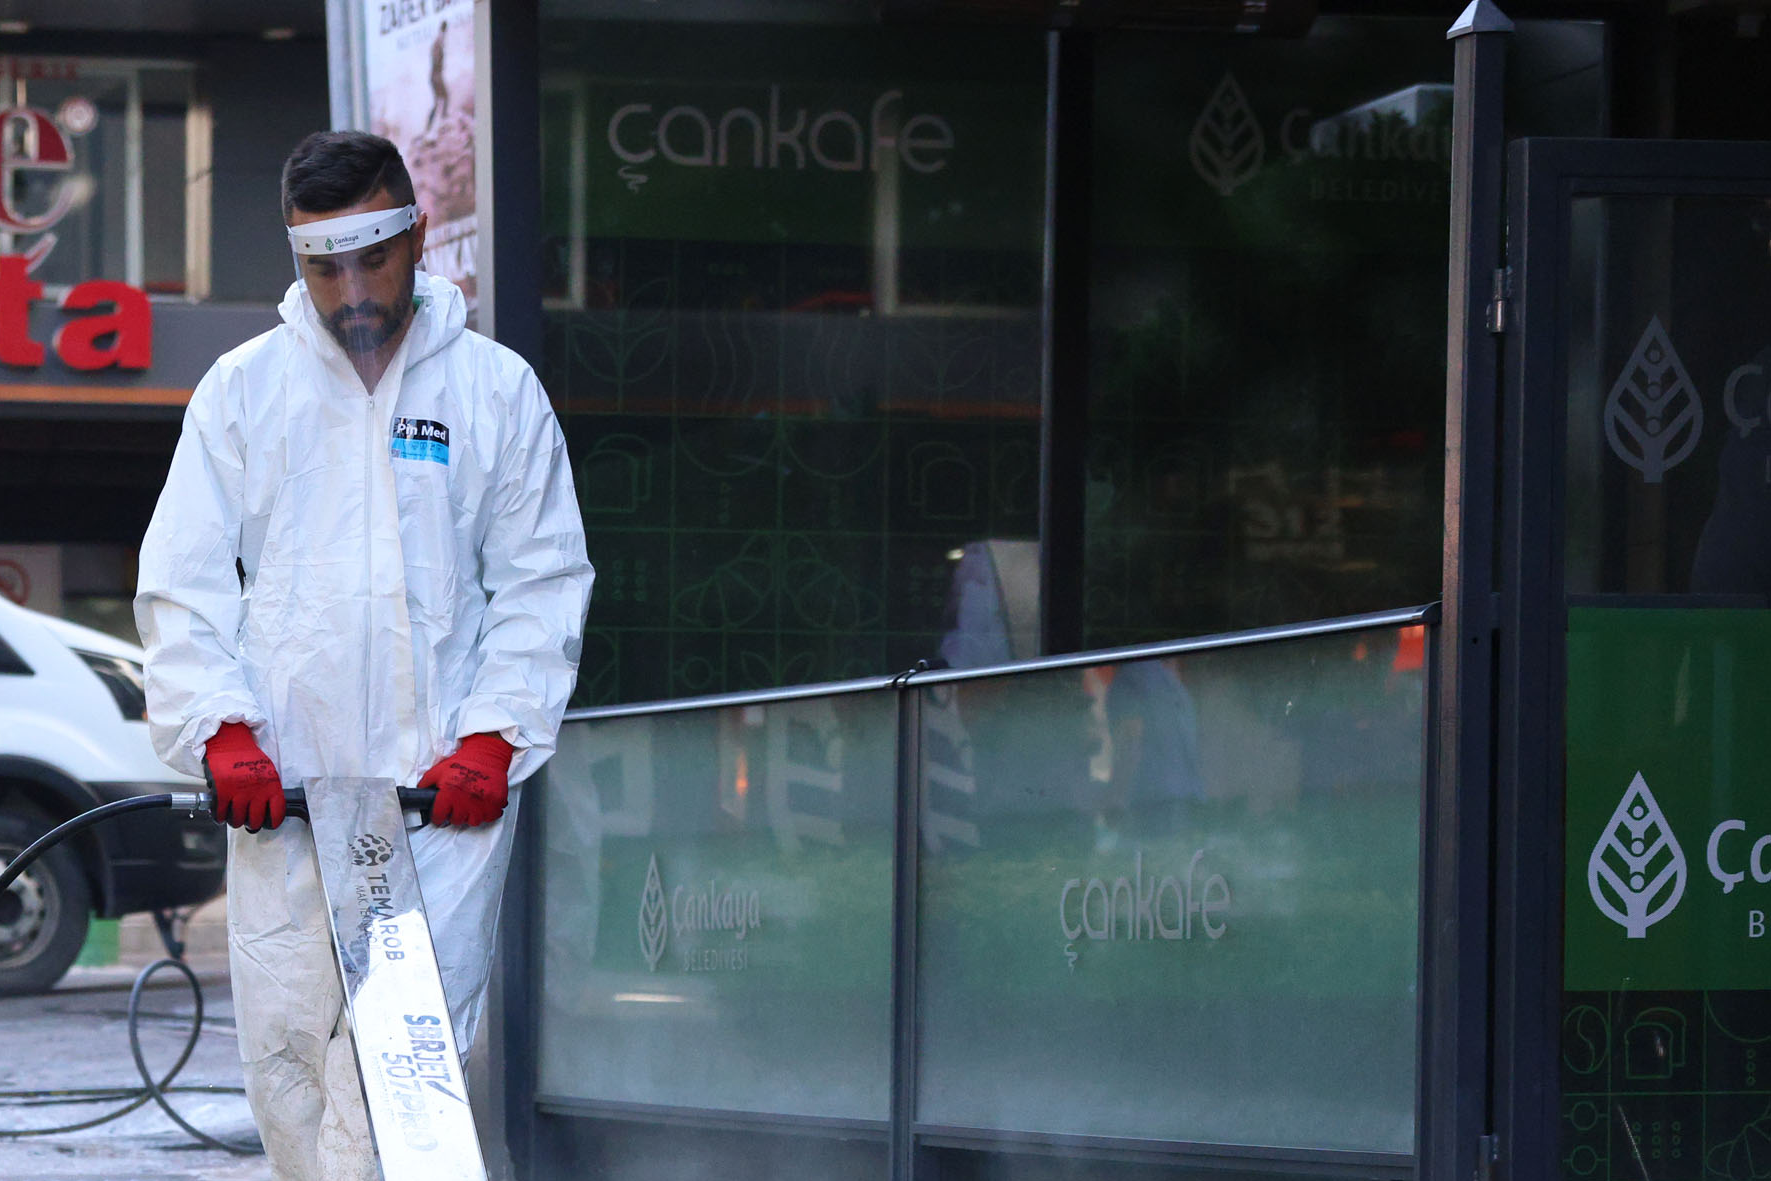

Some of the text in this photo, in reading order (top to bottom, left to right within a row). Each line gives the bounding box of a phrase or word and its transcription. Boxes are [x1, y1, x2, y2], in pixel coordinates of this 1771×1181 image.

[1281, 107, 1452, 167] Çanka
[396, 423, 447, 441] Pin Med
[367, 872, 406, 961] TEMAROB
[672, 880, 761, 940] Çankaya
[1059, 850, 1233, 973] çankafe
